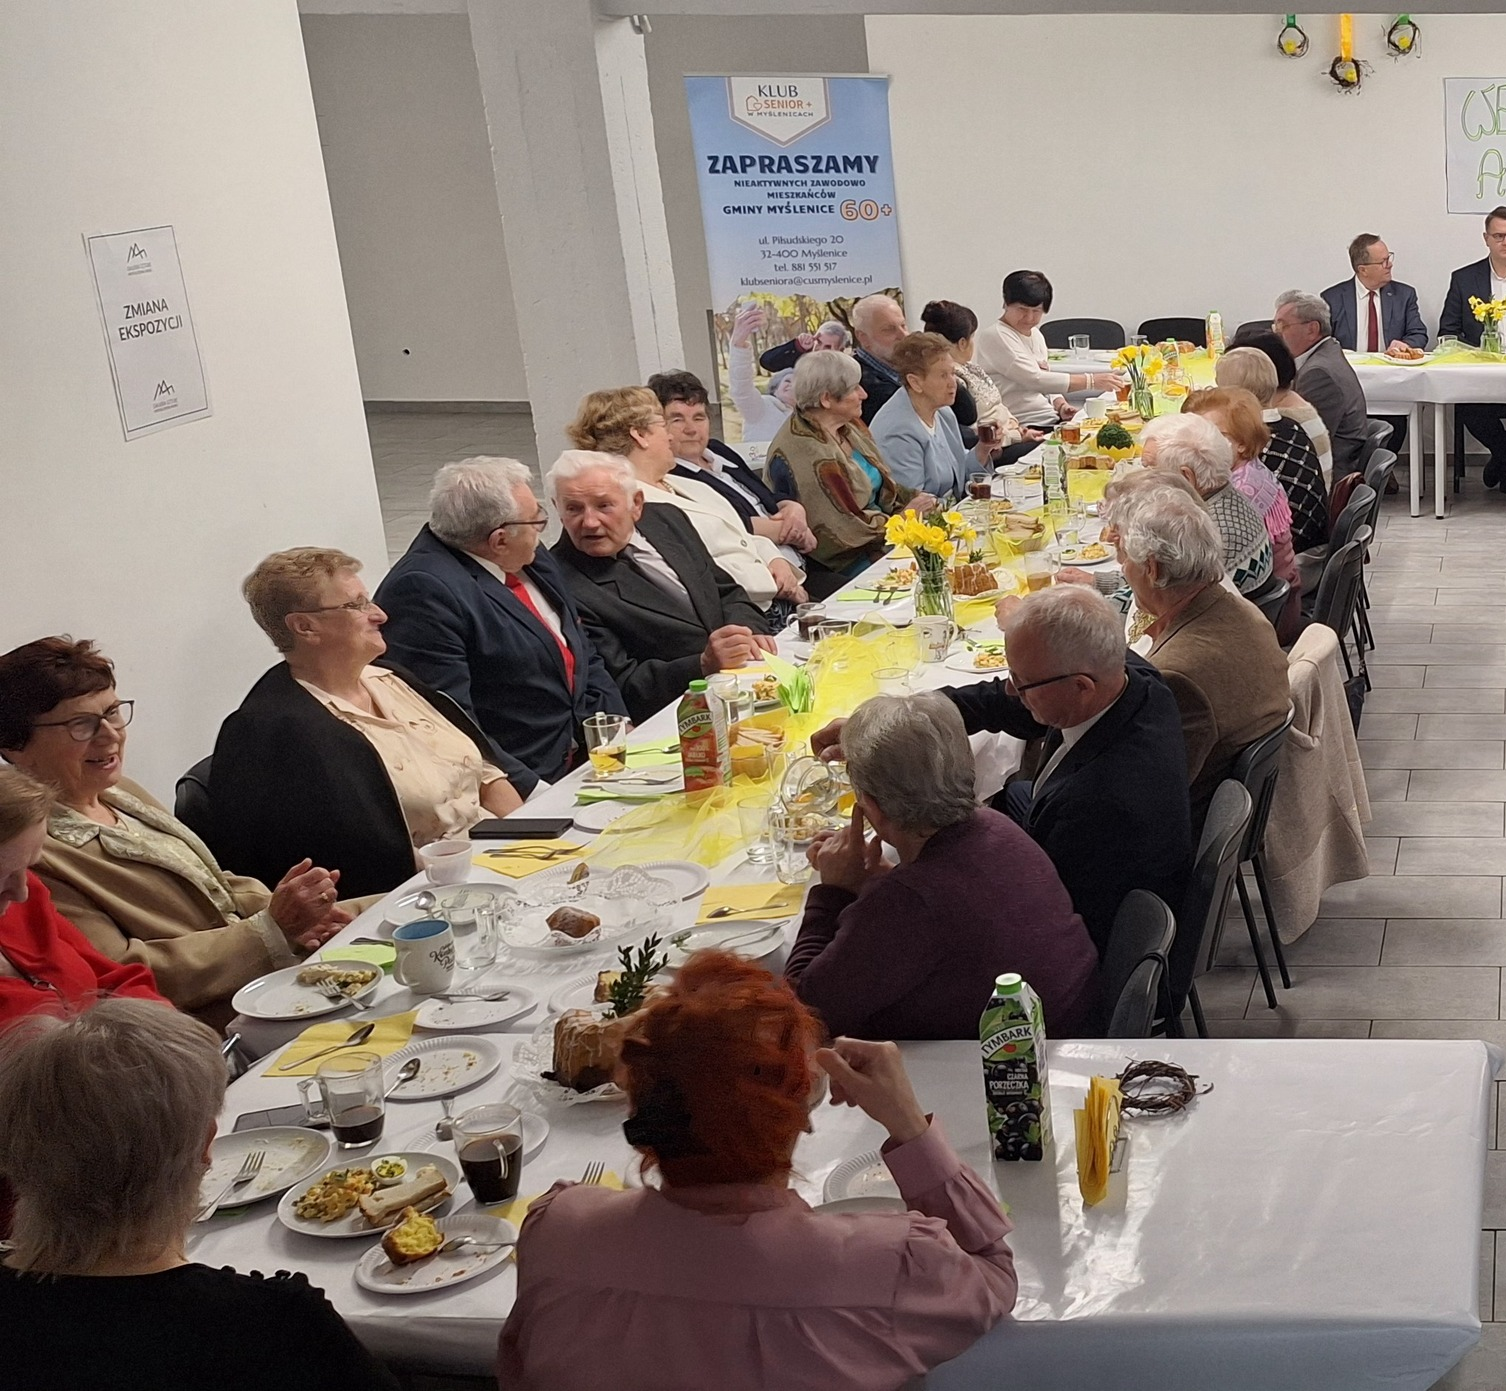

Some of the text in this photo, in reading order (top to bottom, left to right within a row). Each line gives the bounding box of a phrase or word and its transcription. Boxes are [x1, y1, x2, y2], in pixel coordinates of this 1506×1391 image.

[758, 84, 798, 98] KLUB
[763, 99, 804, 109] SENIOR
[757, 110, 814, 118] MYŚLENICACH
[707, 154, 880, 175] ZAPRASZAMY
[734, 179, 866, 188] NIEAKTYWNYCH ZAWODOWO
[767, 188, 836, 199] MIESZKAŃCÓW
[723, 199, 893, 221] GMINY MYŚLENICE 60+
[758, 235, 844, 247] ul. Piłsudskiego 20
[761, 248, 848, 260] 32-400 Myślenice
[774, 262, 837, 272] tel. 881 551 517
[740, 275, 873, 287] klubseniora@cusmyslenice.pl
[123, 298, 169, 320] ZMIANA
[118, 315, 183, 341] EKSPOZYCJI
[981, 1025, 1032, 1054] TYMBARK
